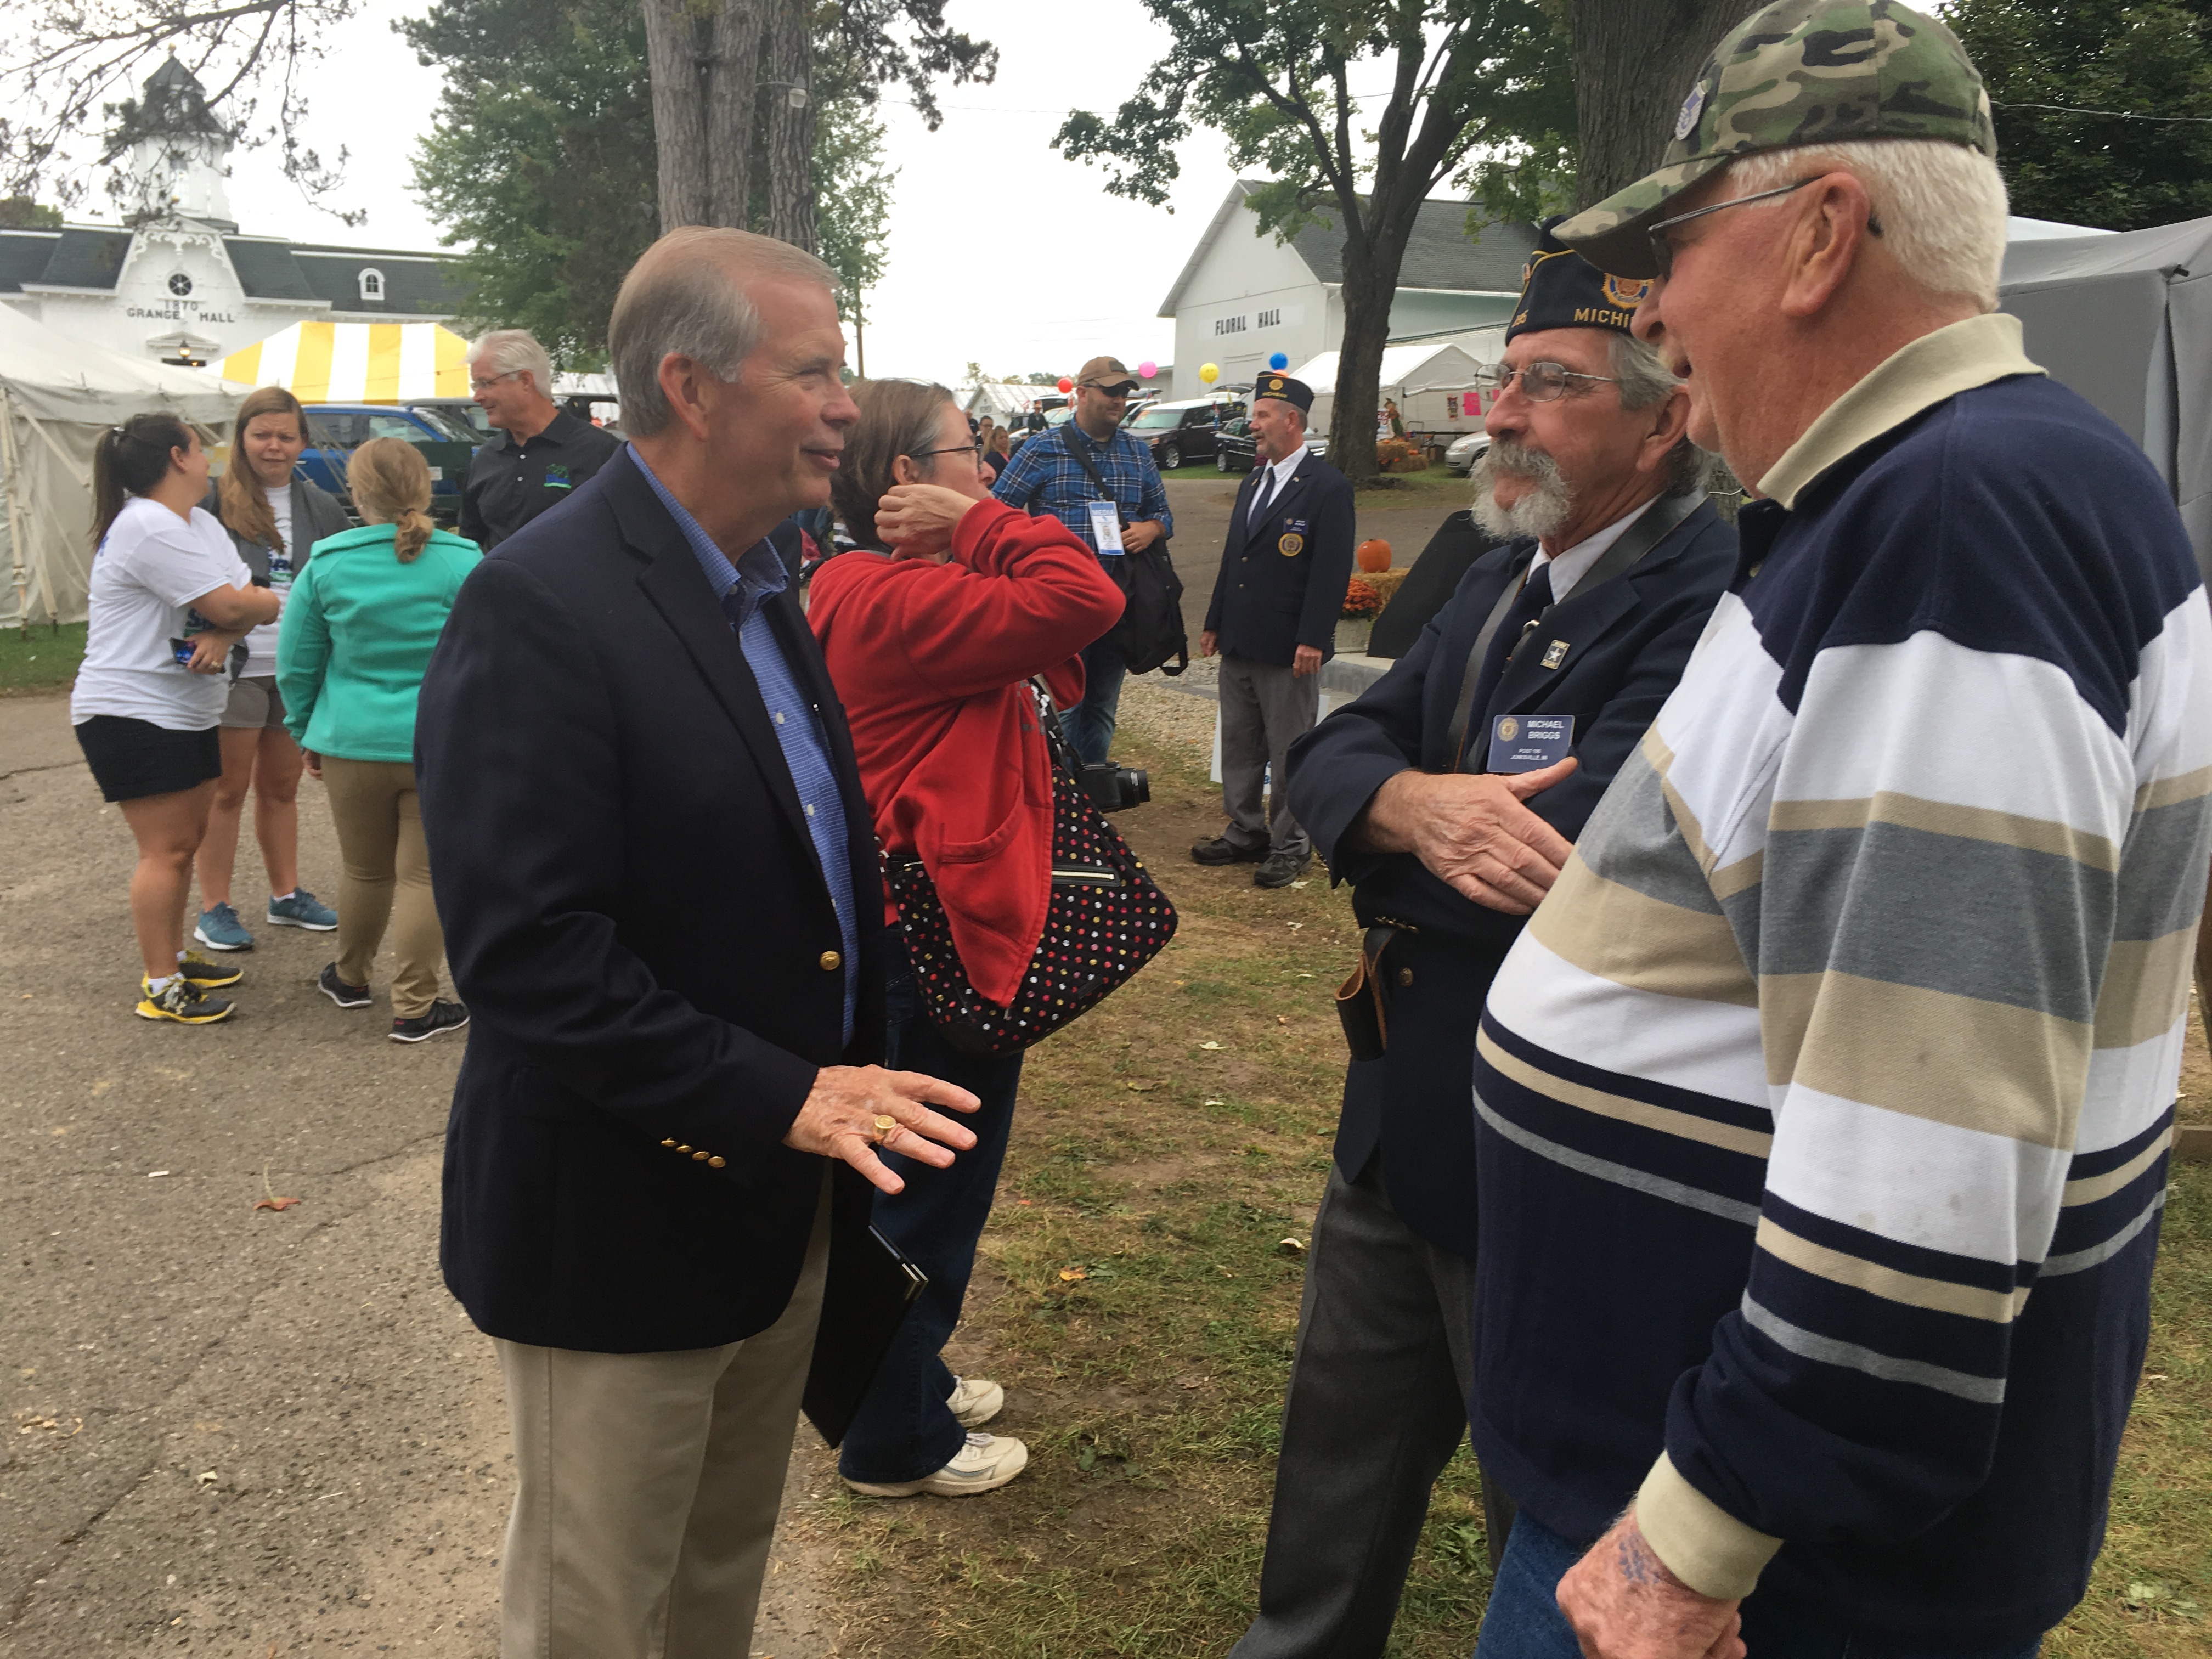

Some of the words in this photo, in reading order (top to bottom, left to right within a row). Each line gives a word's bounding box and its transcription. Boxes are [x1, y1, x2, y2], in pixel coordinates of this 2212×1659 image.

[127, 307, 180, 320] GRANGE
[199, 312, 235, 323] HALL
[1215, 315, 1246, 336] FLORAL
[1258, 308, 1280, 328] HALL
[1573, 308, 1633, 328] MICHI
[1527, 720, 1564, 729] MICHAEL
[1528, 731, 1561, 740] BRIGGS
